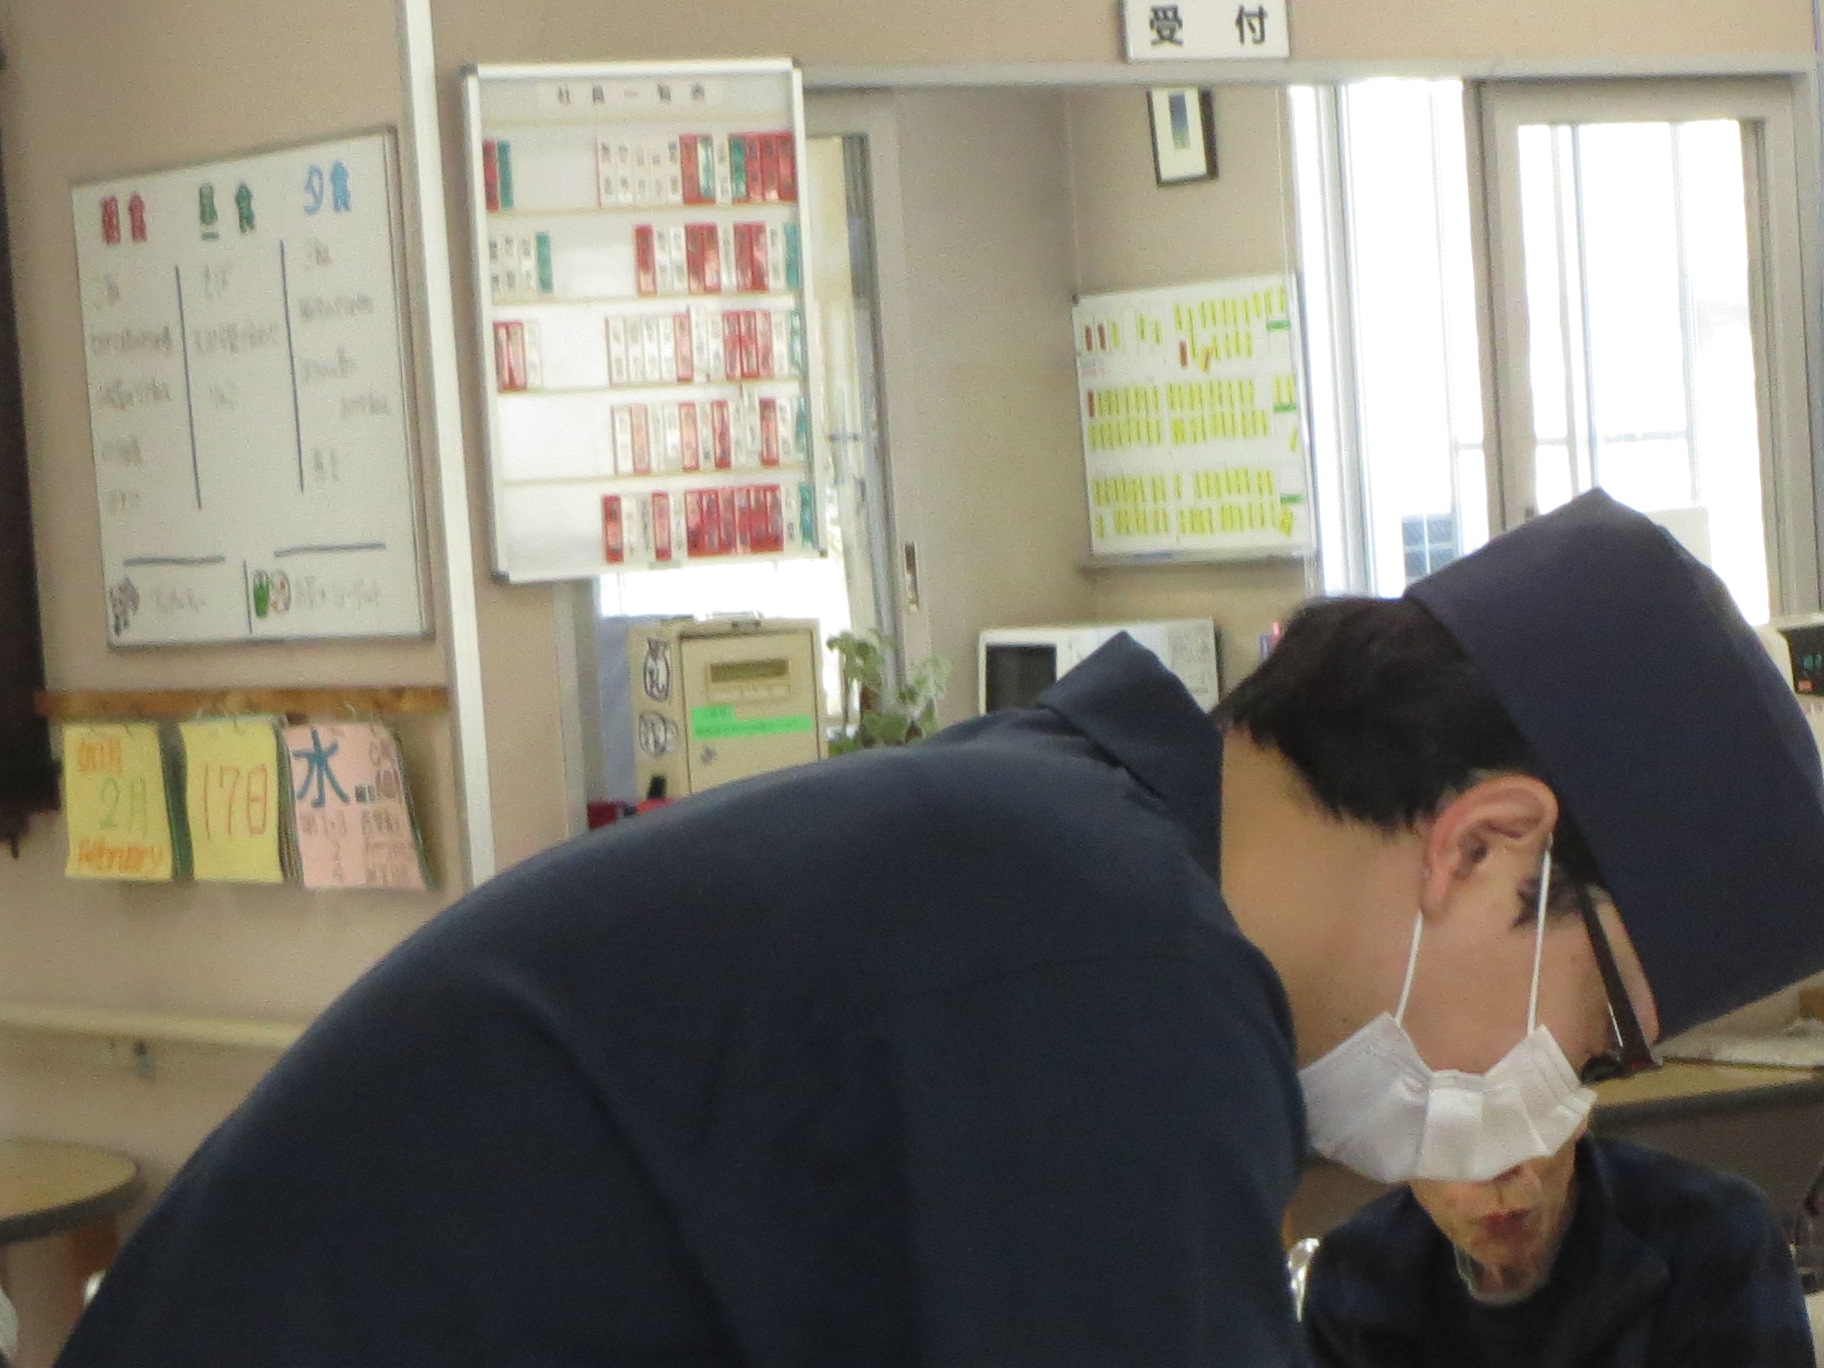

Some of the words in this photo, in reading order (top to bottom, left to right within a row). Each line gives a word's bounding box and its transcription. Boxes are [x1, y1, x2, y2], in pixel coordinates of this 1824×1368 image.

[1150, 5, 1268, 46] 受付
[204, 764, 267, 840] 17日
[292, 729, 350, 809] 水
